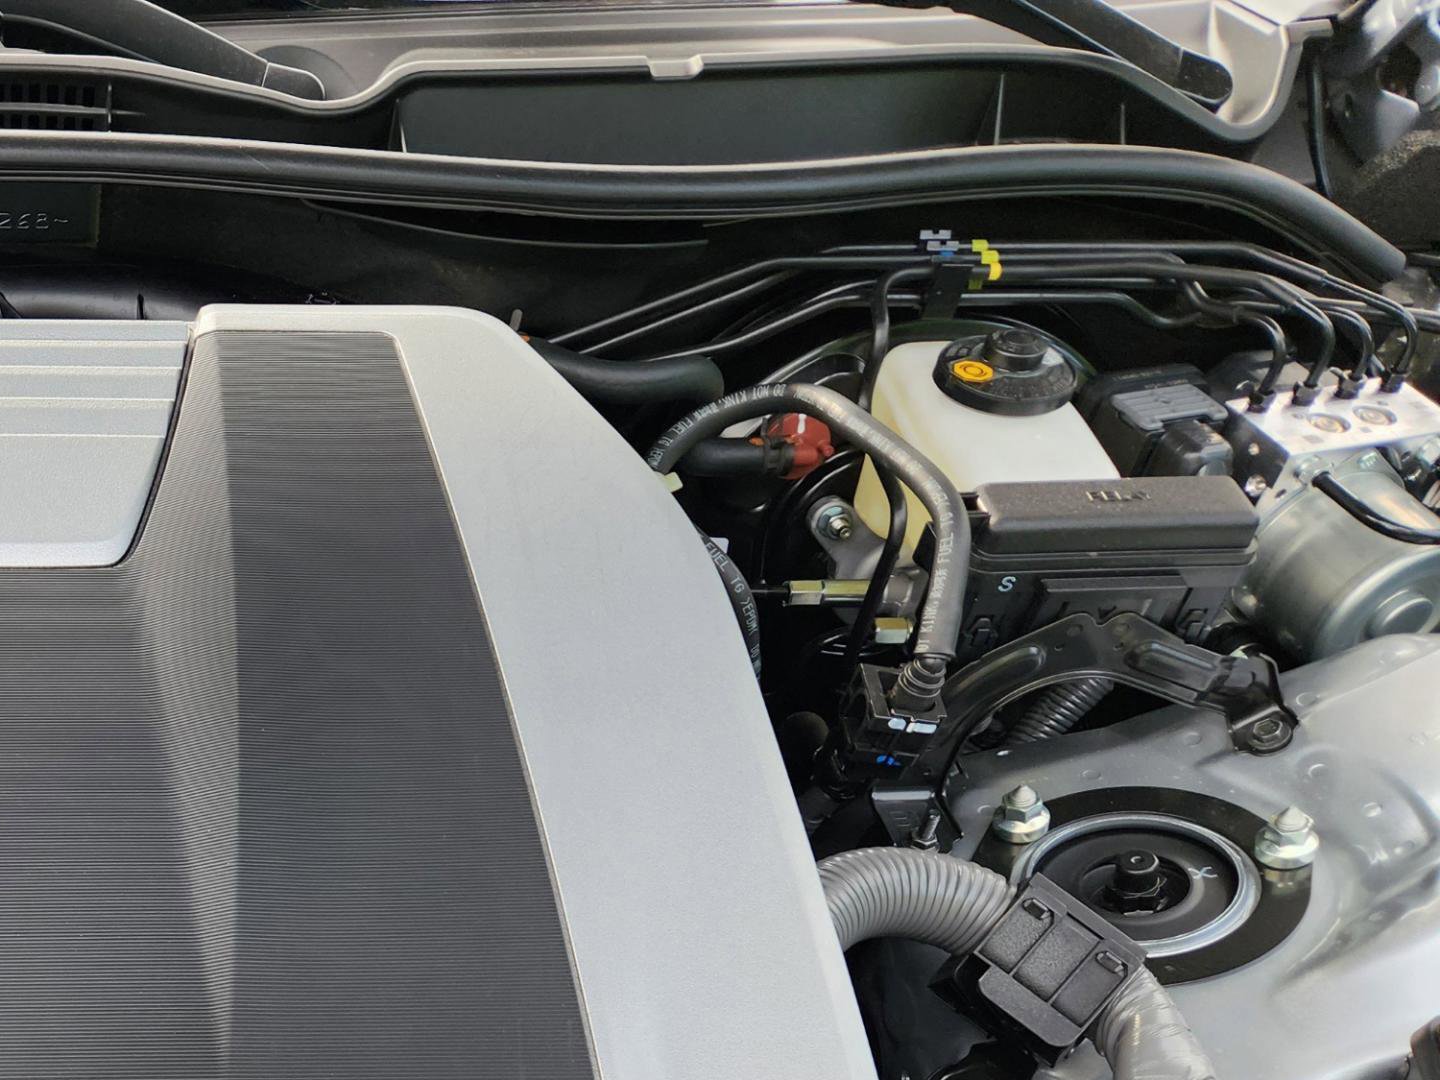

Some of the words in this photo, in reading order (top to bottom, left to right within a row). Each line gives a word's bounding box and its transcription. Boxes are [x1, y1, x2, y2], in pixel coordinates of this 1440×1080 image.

[936, 531, 954, 565] FUEL
[730, 575, 745, 594] TG
[997, 575, 1016, 592] S
